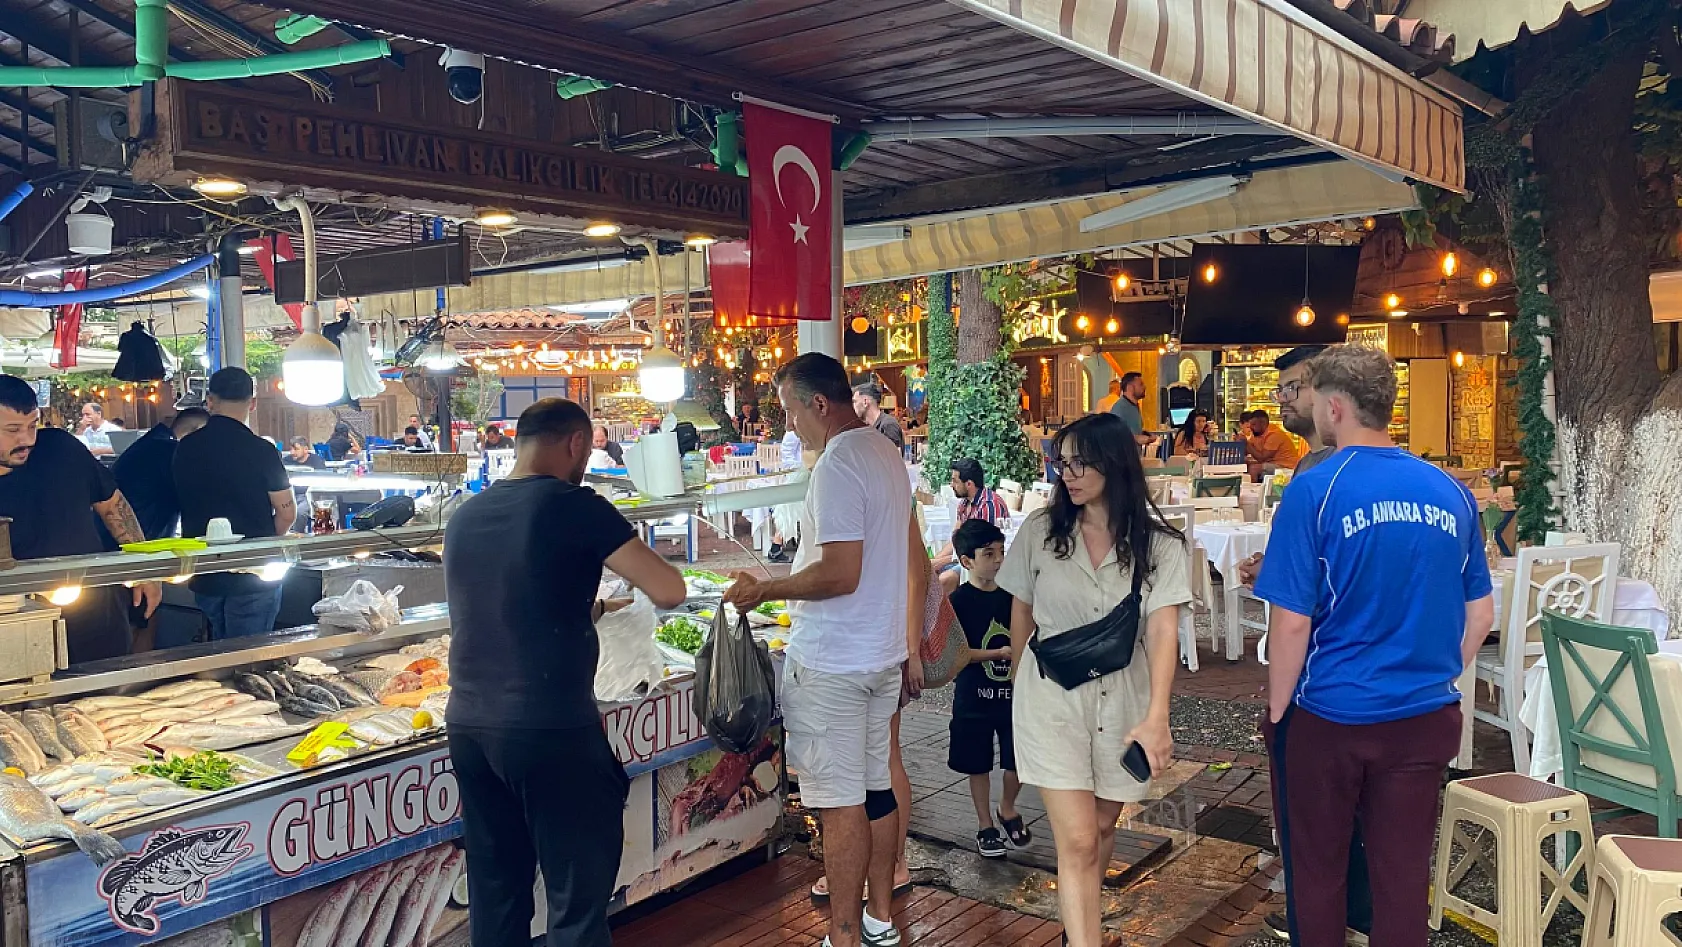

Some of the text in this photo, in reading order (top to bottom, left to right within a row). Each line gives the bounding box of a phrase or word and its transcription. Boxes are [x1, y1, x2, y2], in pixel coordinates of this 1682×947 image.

[1342, 501, 1458, 538] B.B. ANKARA SPOR
[977, 688, 1012, 700] NO FE
